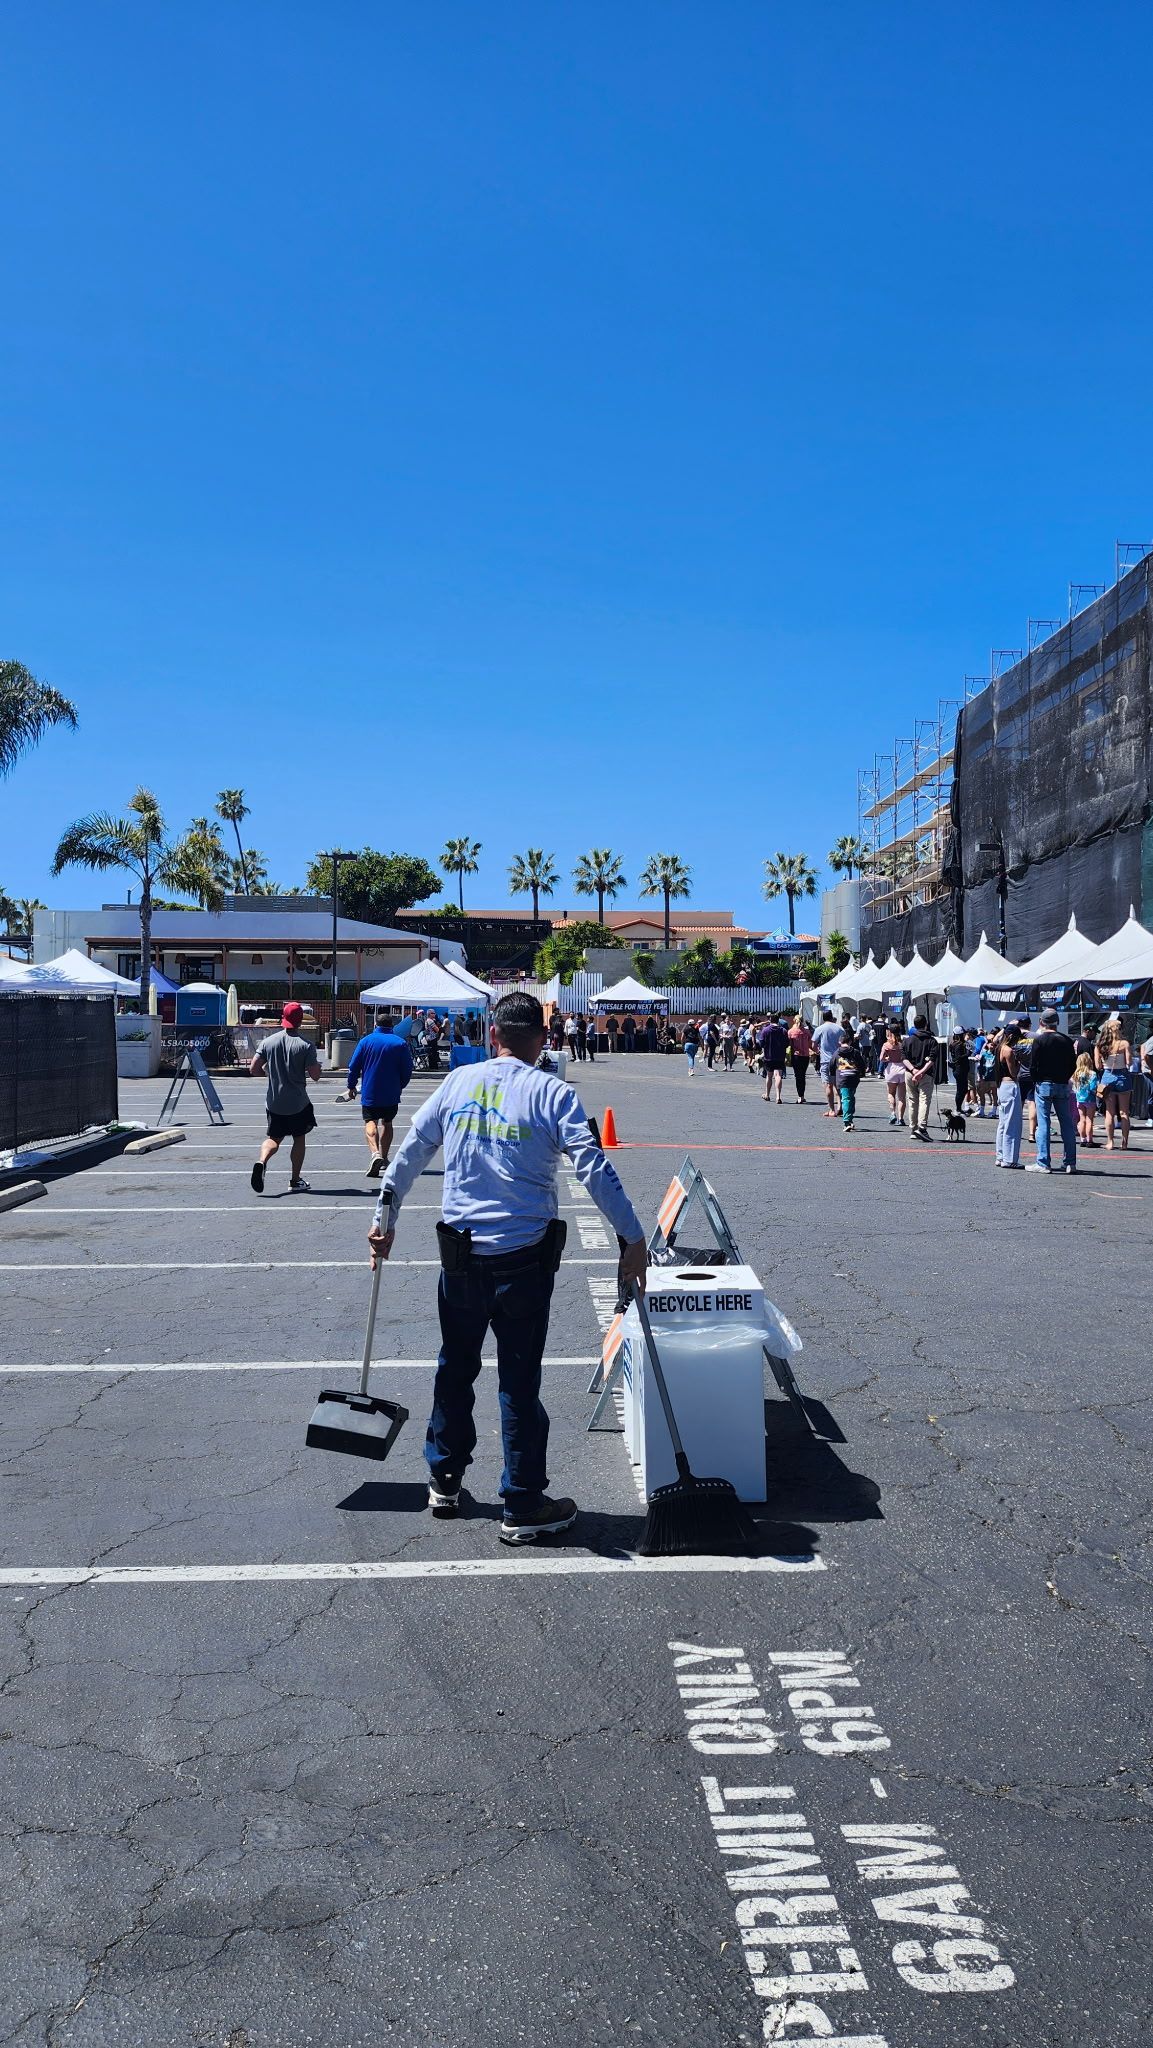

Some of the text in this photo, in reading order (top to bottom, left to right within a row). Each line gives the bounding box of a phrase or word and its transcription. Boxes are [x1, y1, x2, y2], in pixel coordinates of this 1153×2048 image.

[161, 1039, 210, 1047] LSBAD5000
[496, 1139, 520, 1148] GROUP
[649, 1294, 752, 1312] RECYCLE HERE
[768, 1651, 1015, 1993] 6AM - 6PM
[667, 1641, 889, 2048] PERMIT ONLY
